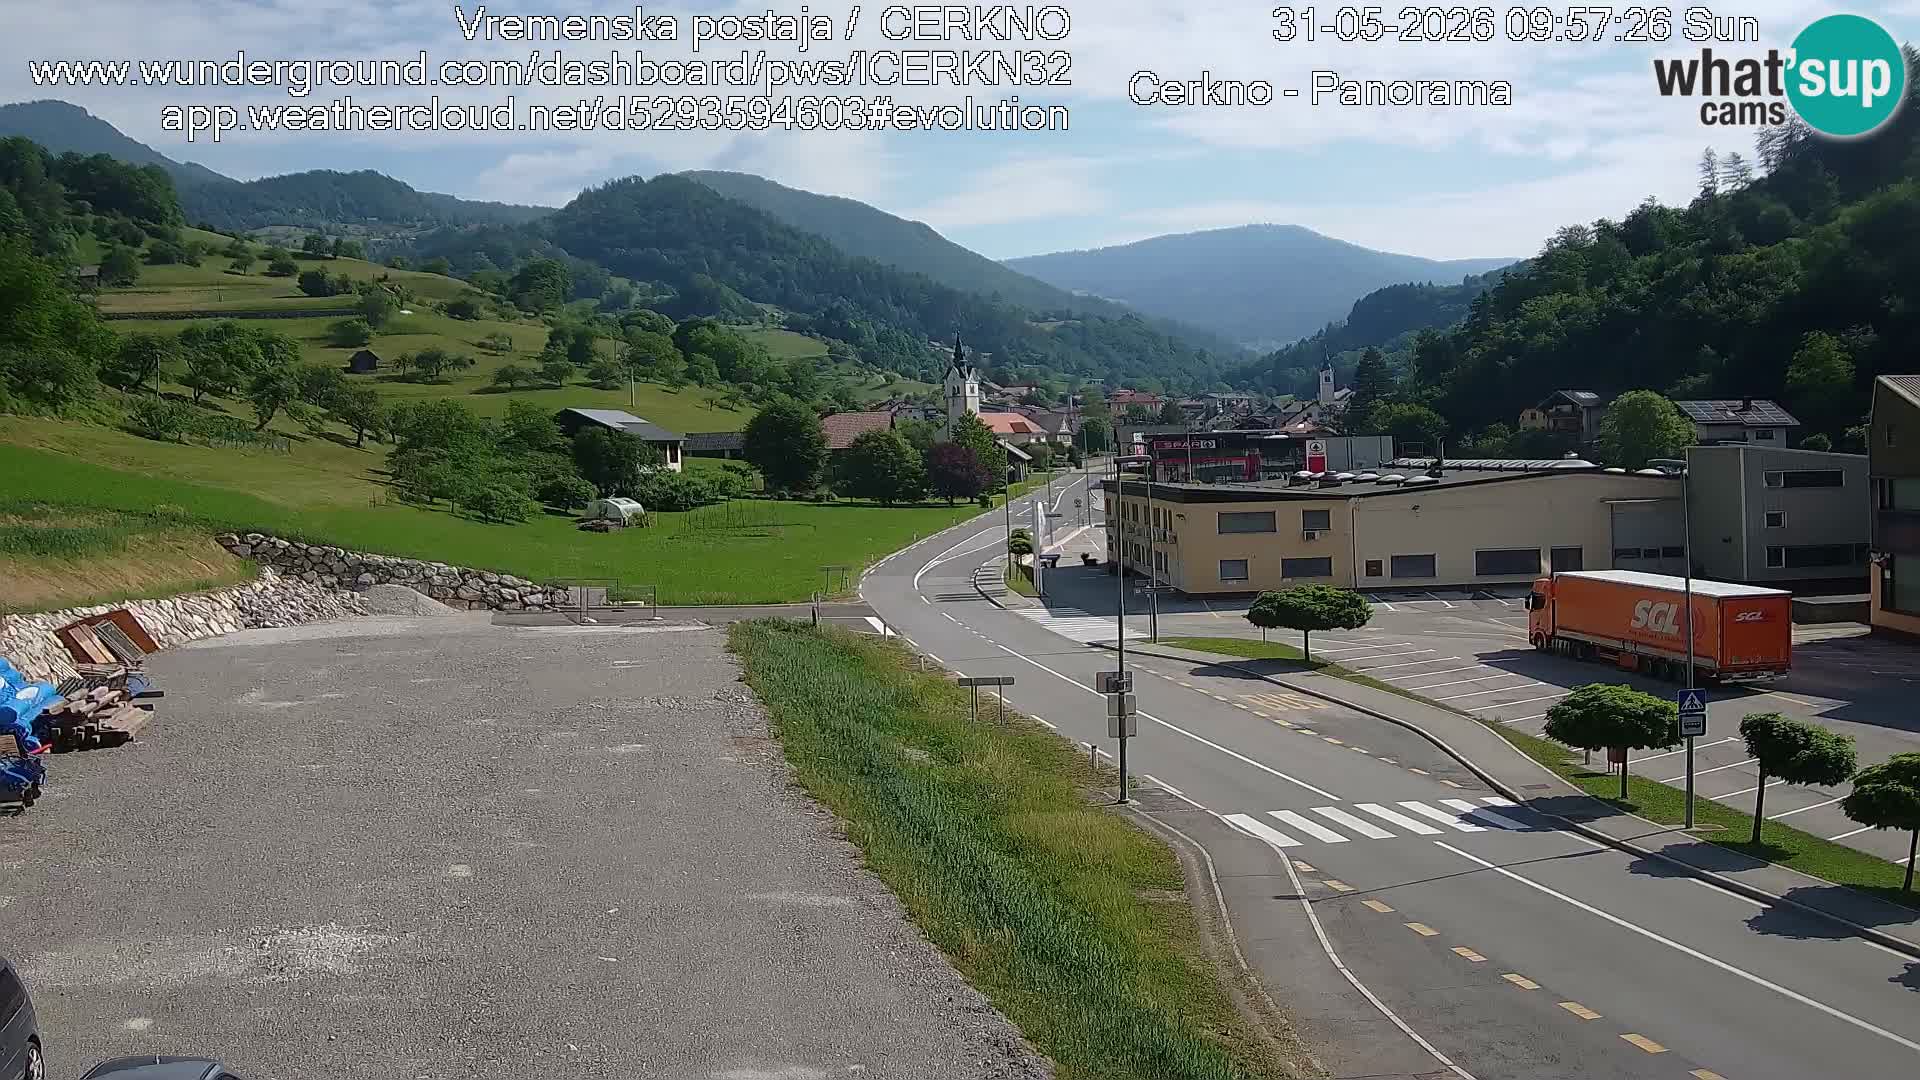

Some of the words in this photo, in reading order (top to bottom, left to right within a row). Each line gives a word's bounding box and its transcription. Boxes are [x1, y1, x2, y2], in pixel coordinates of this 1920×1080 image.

[1163, 440, 1200, 449] SPAR
[1631, 600, 1680, 634] SGL
[1735, 611, 1763, 622] SGL
